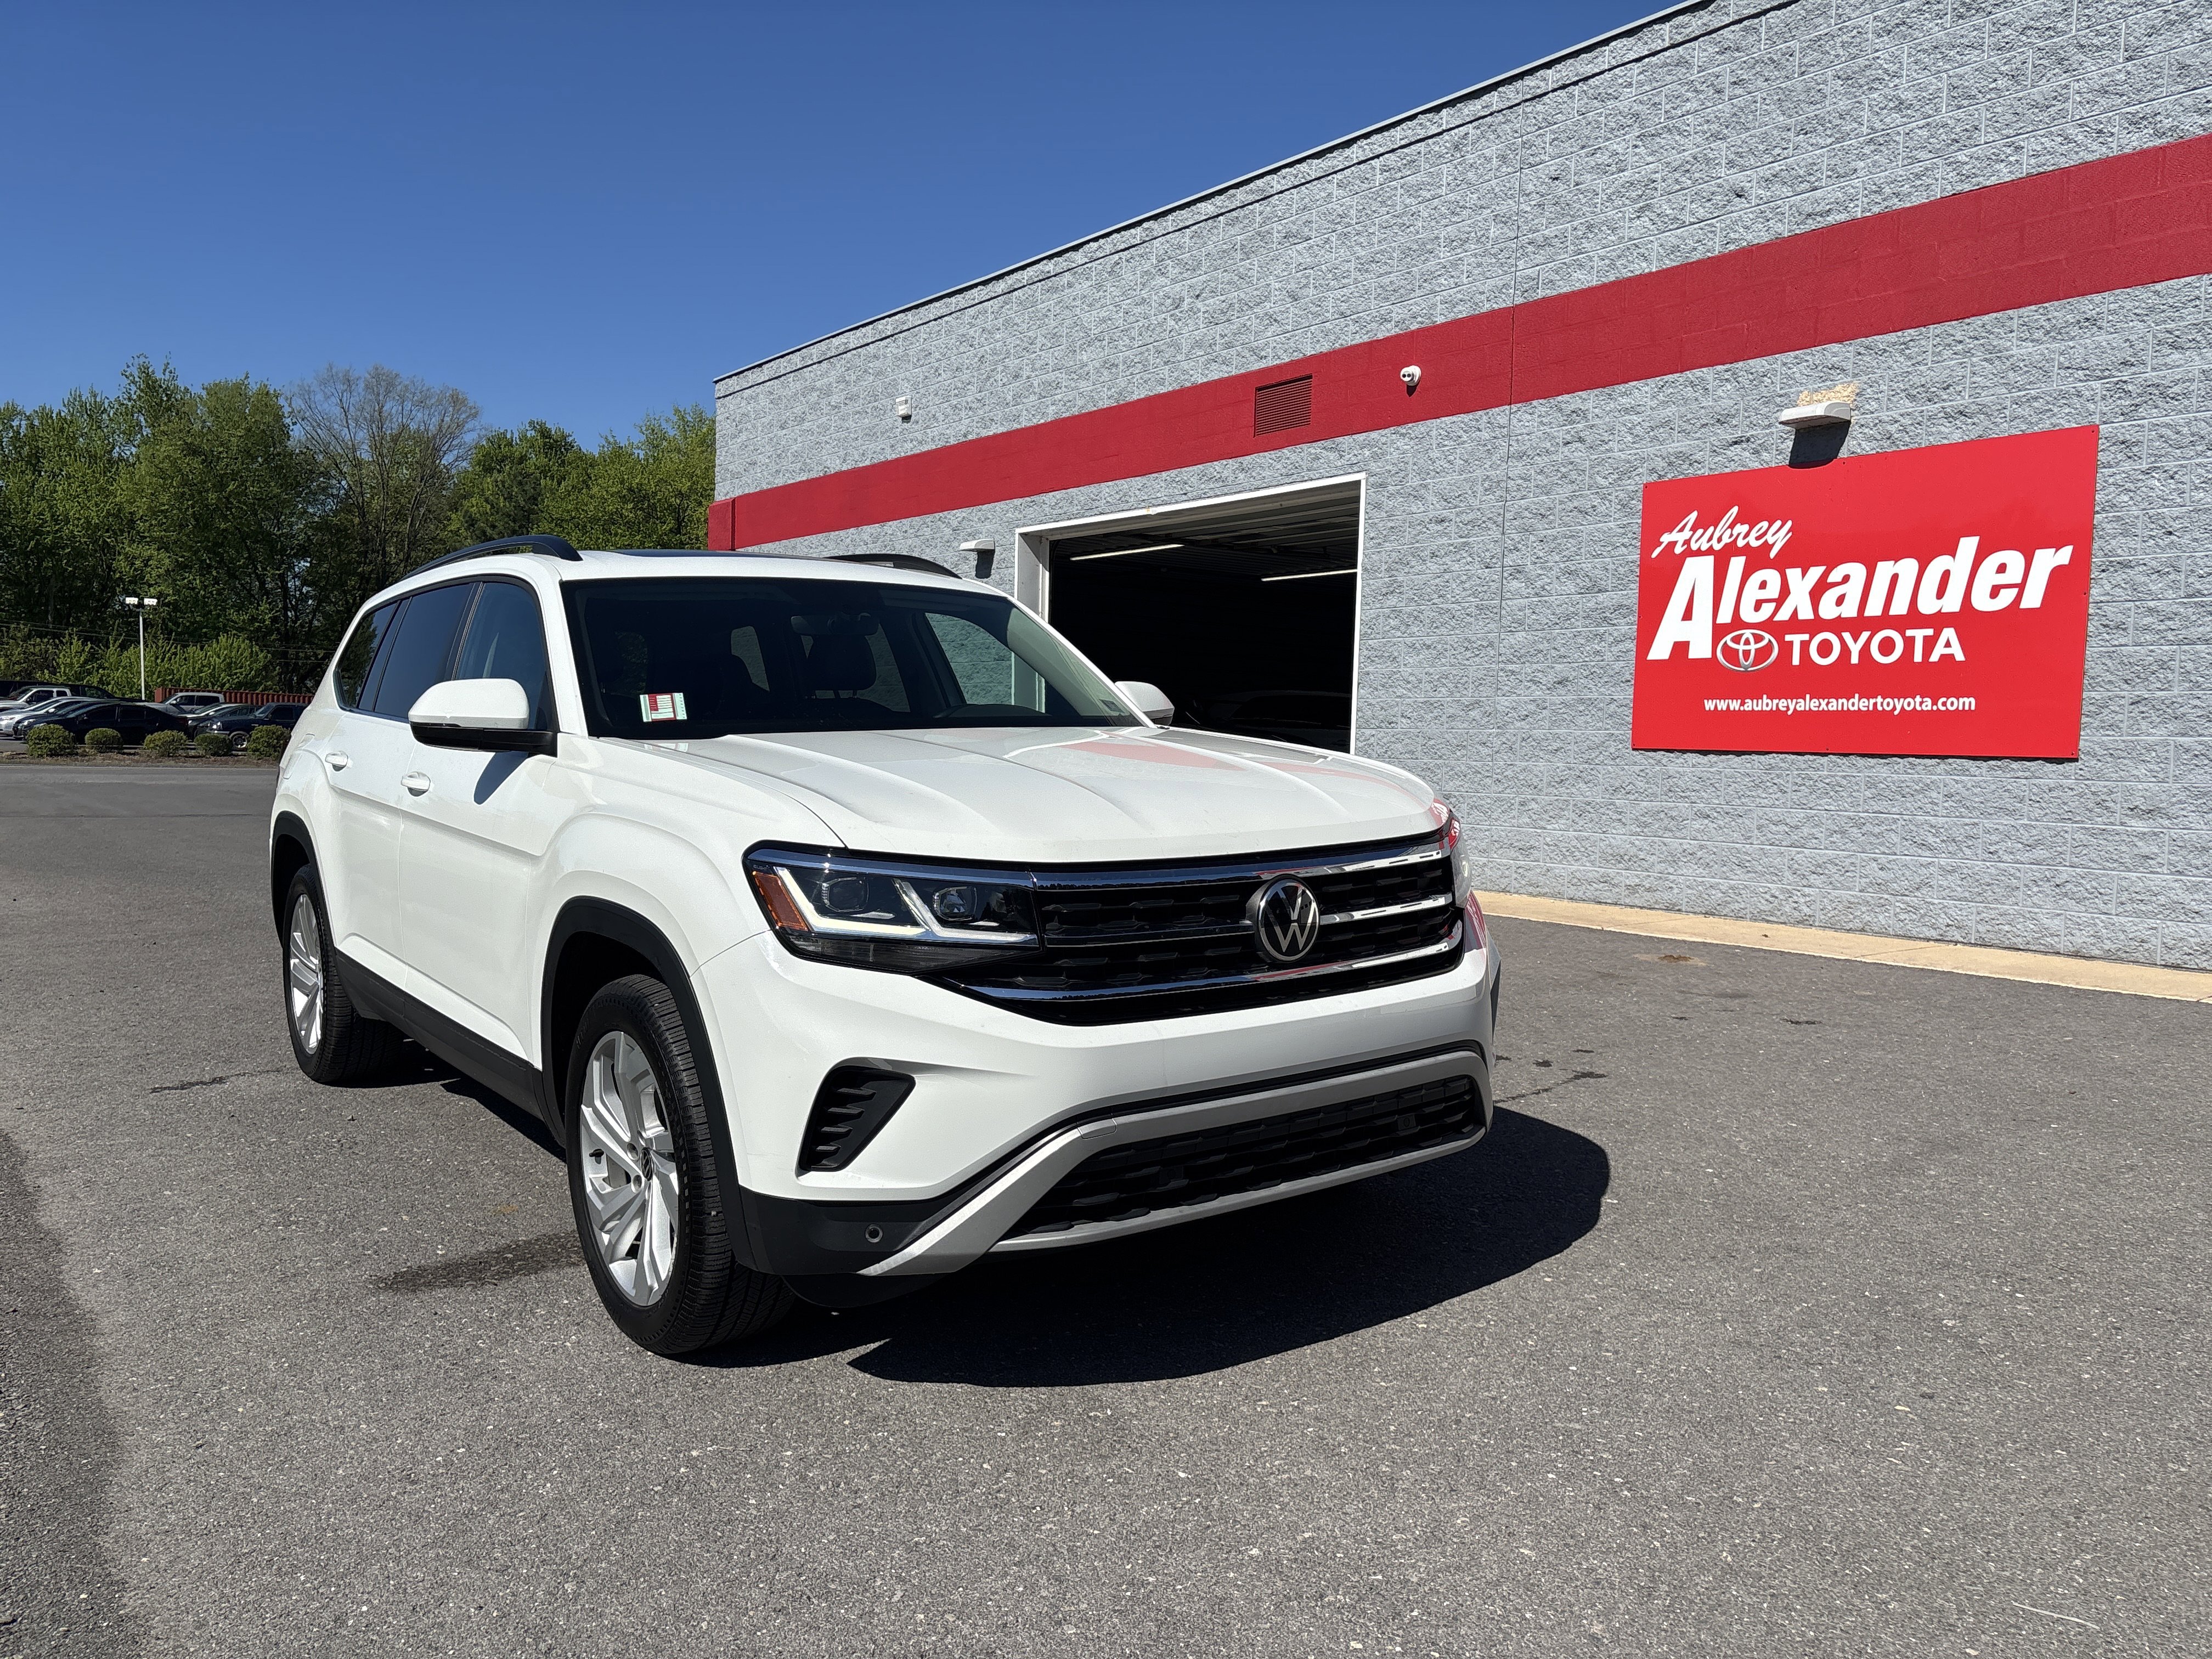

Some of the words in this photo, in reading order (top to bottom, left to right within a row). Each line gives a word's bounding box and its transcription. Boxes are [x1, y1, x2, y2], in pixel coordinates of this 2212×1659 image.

[1651, 505, 1792, 559] Aubrey
[1646, 535, 2074, 661] Alexander
[1784, 627, 1966, 665] TOYOTA
[1703, 693, 1976, 715] www.aubreyalexandertoyota.com
[1260, 882, 1318, 957] VW
